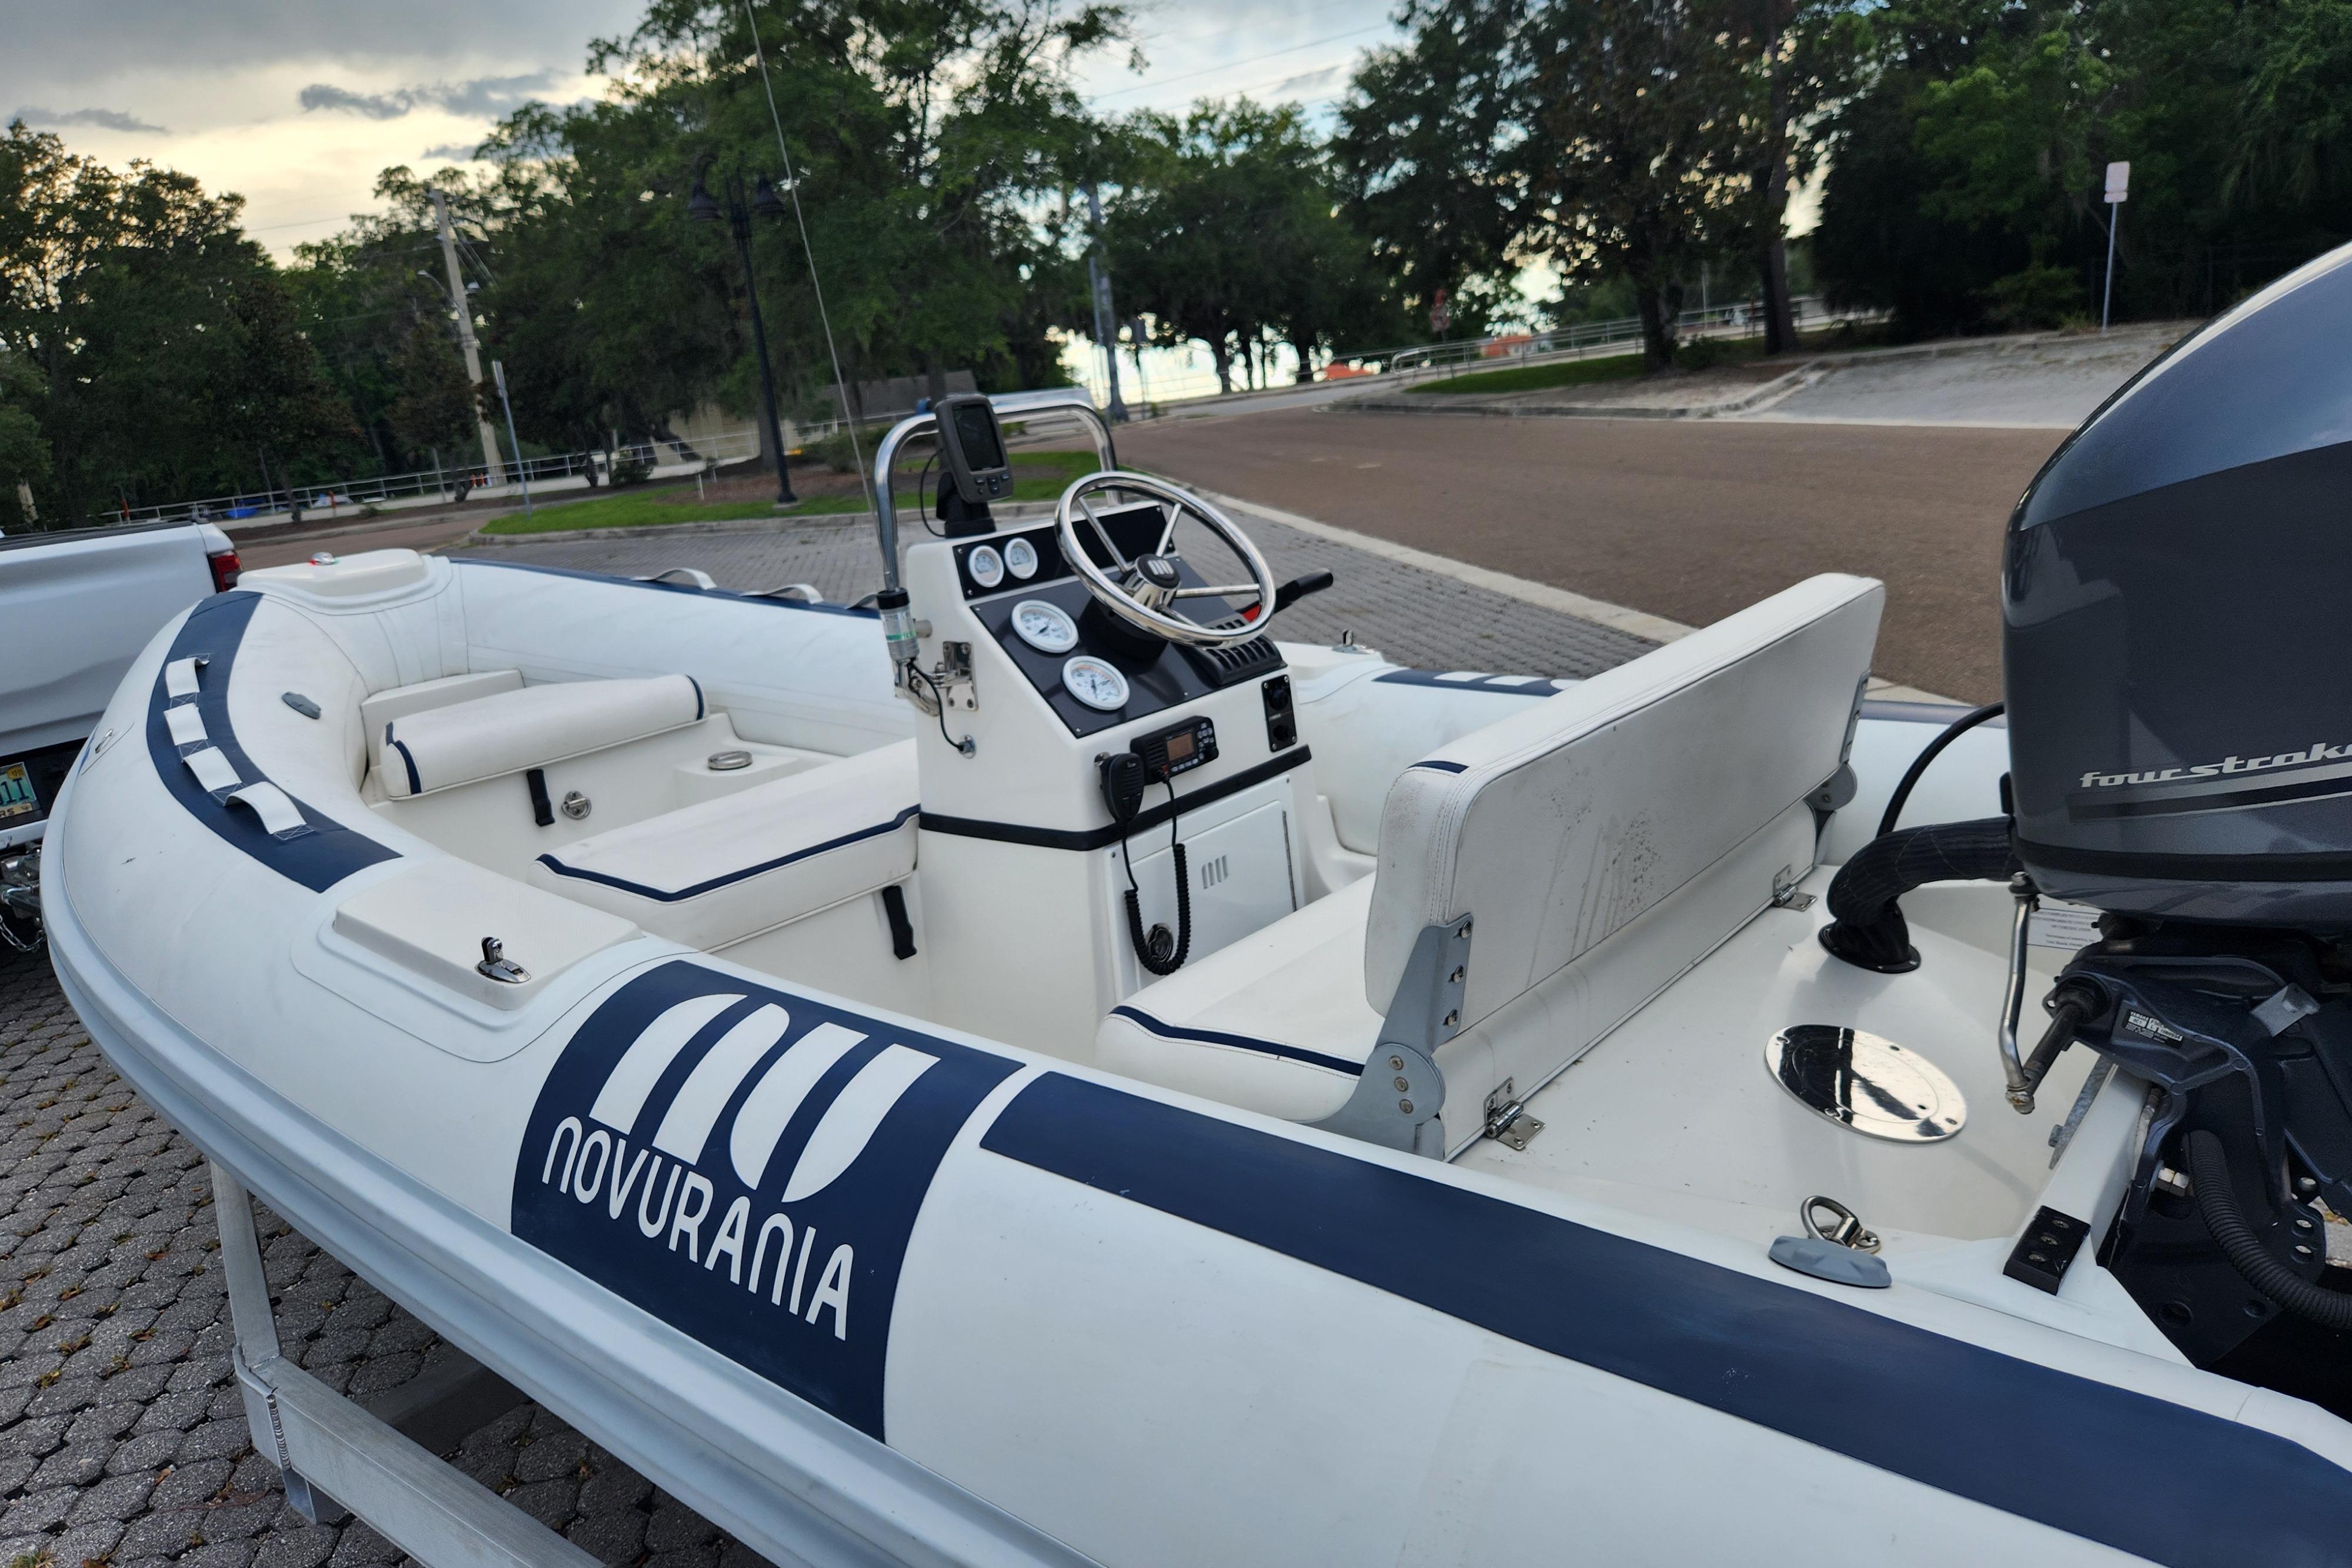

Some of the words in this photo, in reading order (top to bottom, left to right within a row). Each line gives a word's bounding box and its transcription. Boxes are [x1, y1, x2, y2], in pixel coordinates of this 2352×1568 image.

[2080, 768, 2181, 788] four
[2130, 1011, 2149, 1021] YAMAHA
[542, 1116, 854, 1341] NOVURANIA
